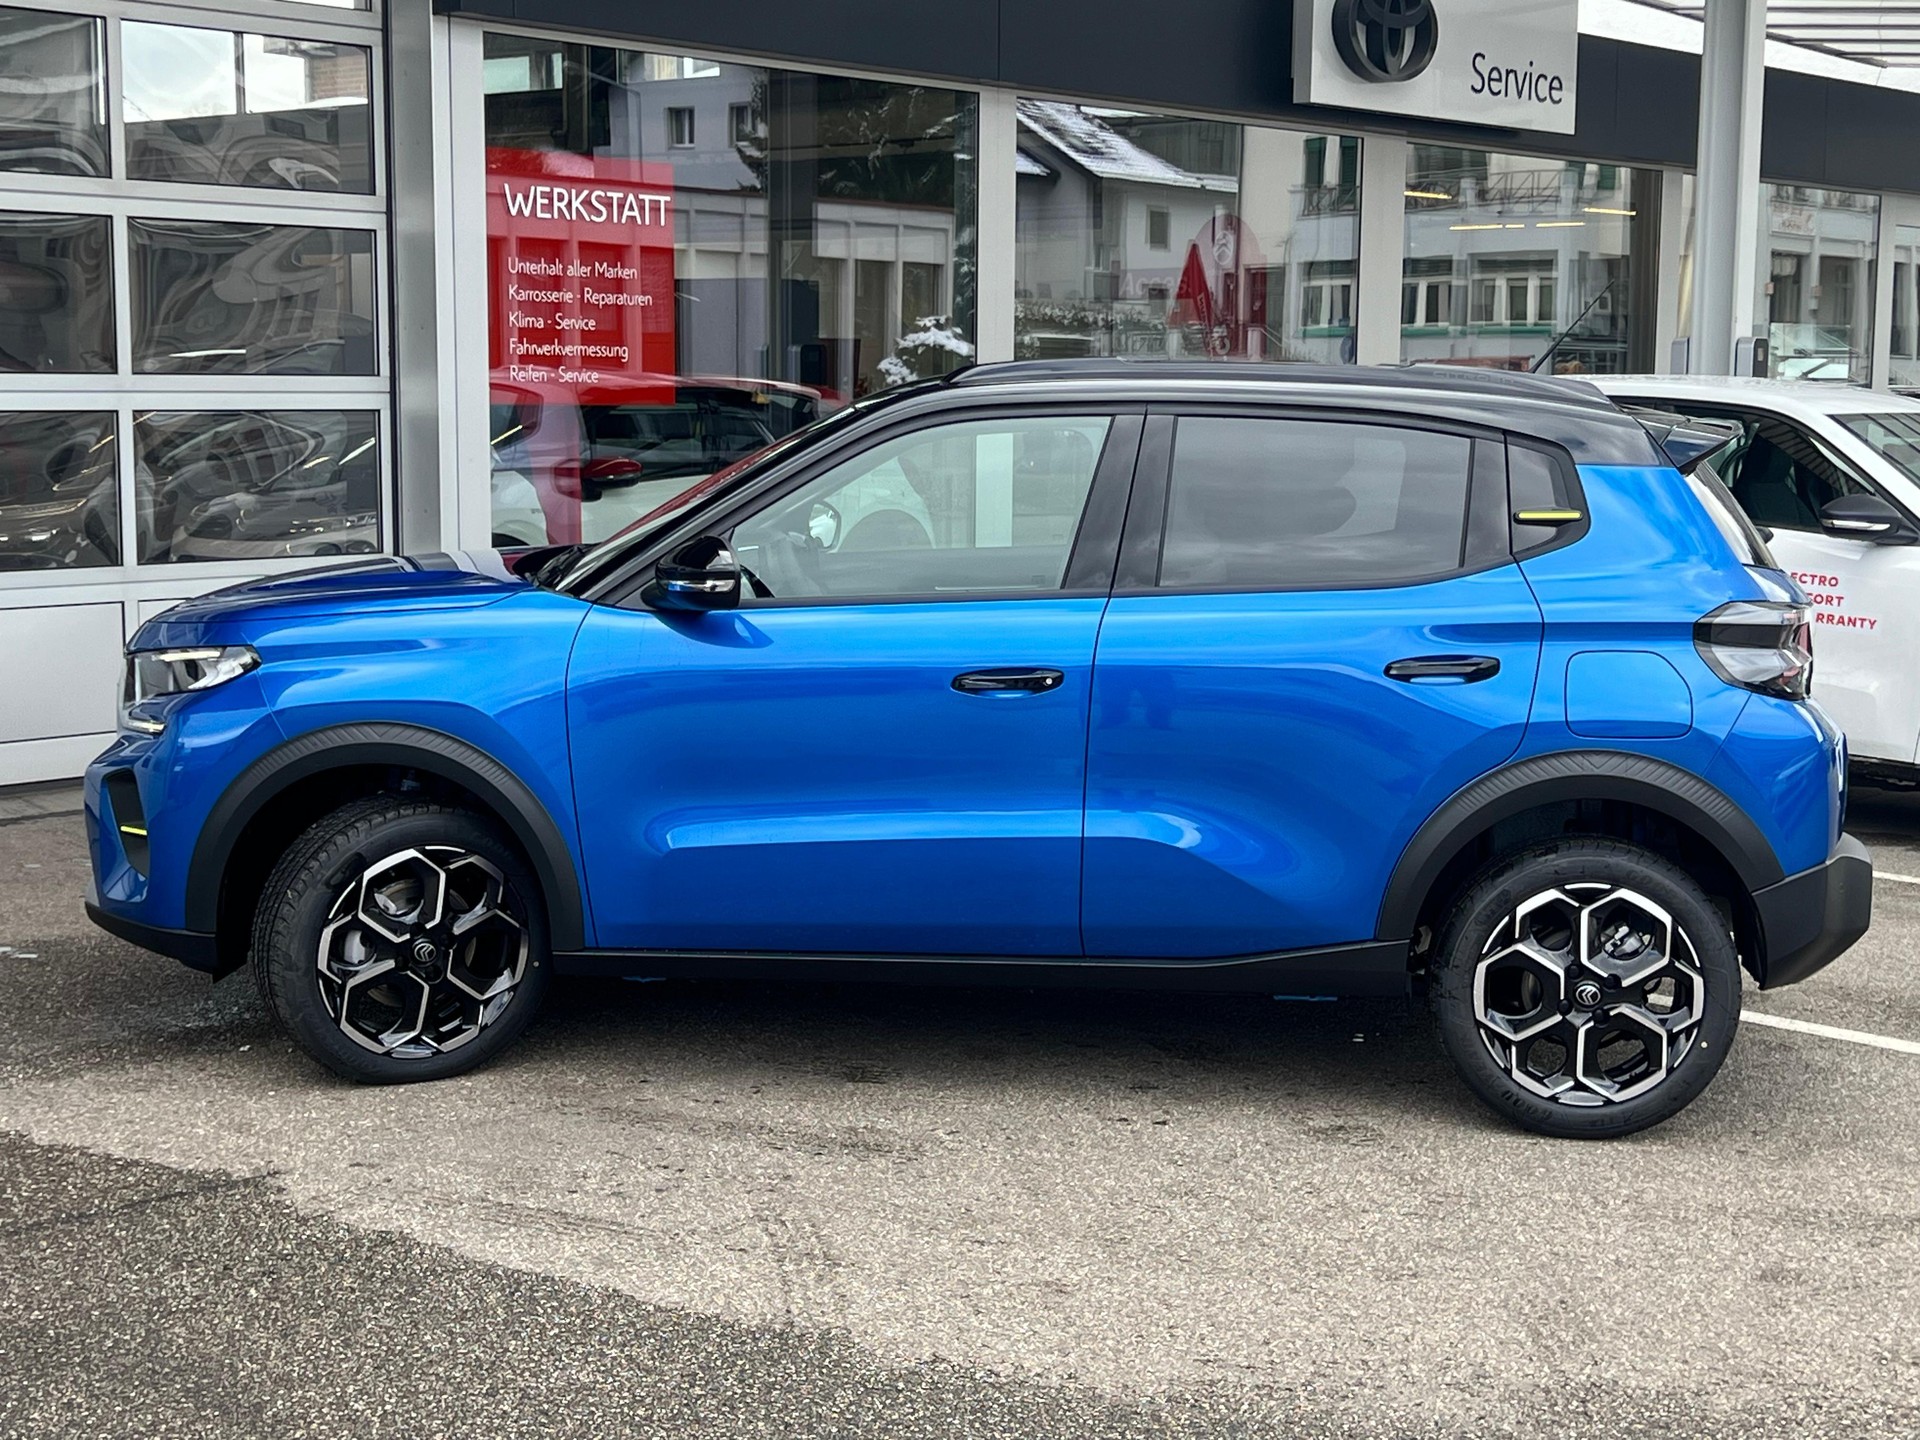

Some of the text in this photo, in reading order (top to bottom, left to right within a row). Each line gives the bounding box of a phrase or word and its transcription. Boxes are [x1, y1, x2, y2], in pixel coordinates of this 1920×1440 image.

[1470, 52, 1563, 105] Service
[503, 183, 671, 227] WERKSTATT
[508, 257, 638, 279] Unterhalt aller Marken
[508, 284, 574, 303] Karrosserie
[583, 287, 653, 309] Reparaturen
[508, 310, 544, 329] Klima
[555, 312, 596, 331] Service
[509, 337, 629, 363] Fahrwerkvermessung
[509, 364, 547, 382] Reifen
[558, 365, 599, 383] Service
[1815, 613, 1877, 630] RRANTY
